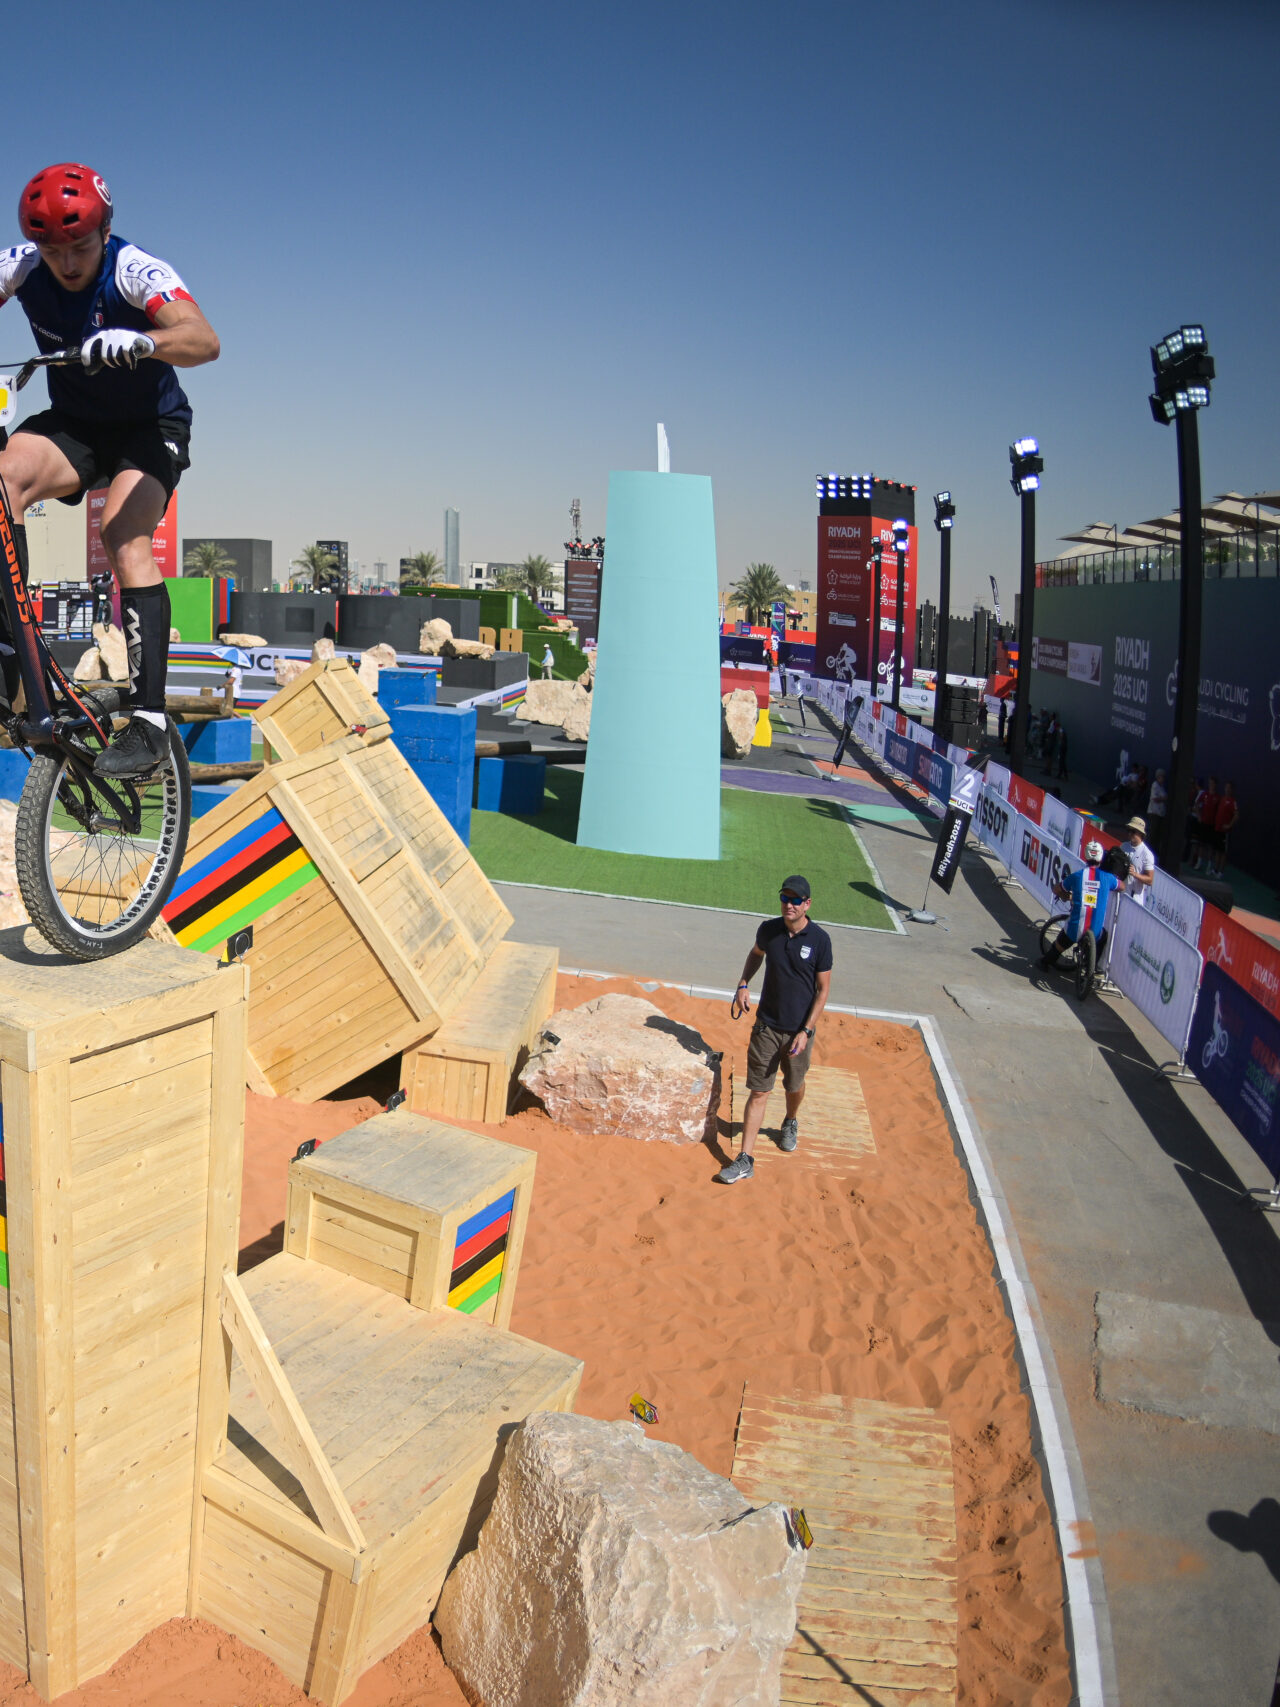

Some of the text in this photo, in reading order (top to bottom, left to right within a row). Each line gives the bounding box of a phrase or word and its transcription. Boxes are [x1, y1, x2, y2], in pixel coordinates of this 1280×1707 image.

[126, 262, 164, 281] CIC
[828, 526, 861, 538] RIYADH
[1114, 636, 1150, 671] RIYADH
[1113, 673, 1149, 704] 2025 UCI
[1214, 681, 1249, 706] CYCLING
[960, 773, 975, 798] 2
[956, 798, 969, 811] UCI
[975, 792, 1009, 843] TISSOT
[937, 818, 962, 877] #Riyadh2025
[1252, 961, 1280, 994] RIYADH
